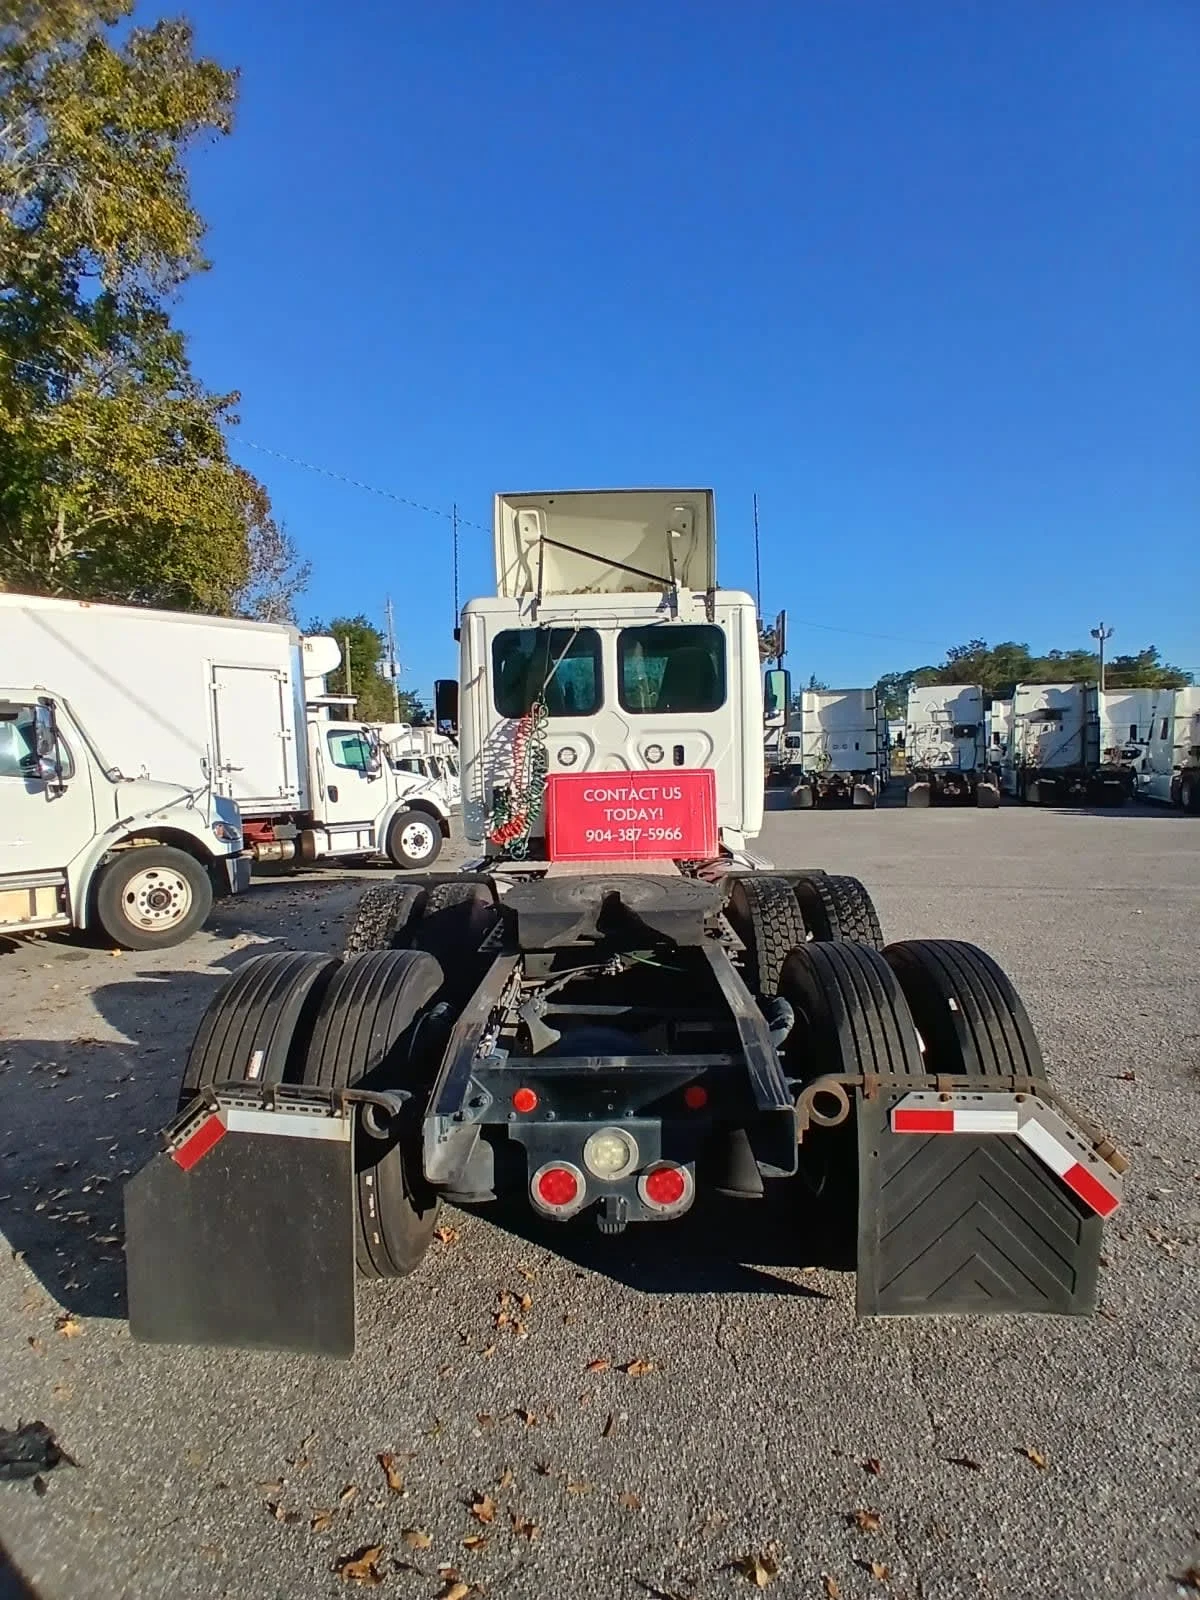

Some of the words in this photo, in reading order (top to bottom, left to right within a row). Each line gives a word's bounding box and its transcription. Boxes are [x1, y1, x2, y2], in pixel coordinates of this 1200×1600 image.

[583, 787, 659, 802] CONTACT
[662, 787, 682, 800] US
[603, 808, 663, 821] TODAY!
[586, 828, 682, 842] 904-387-5966
